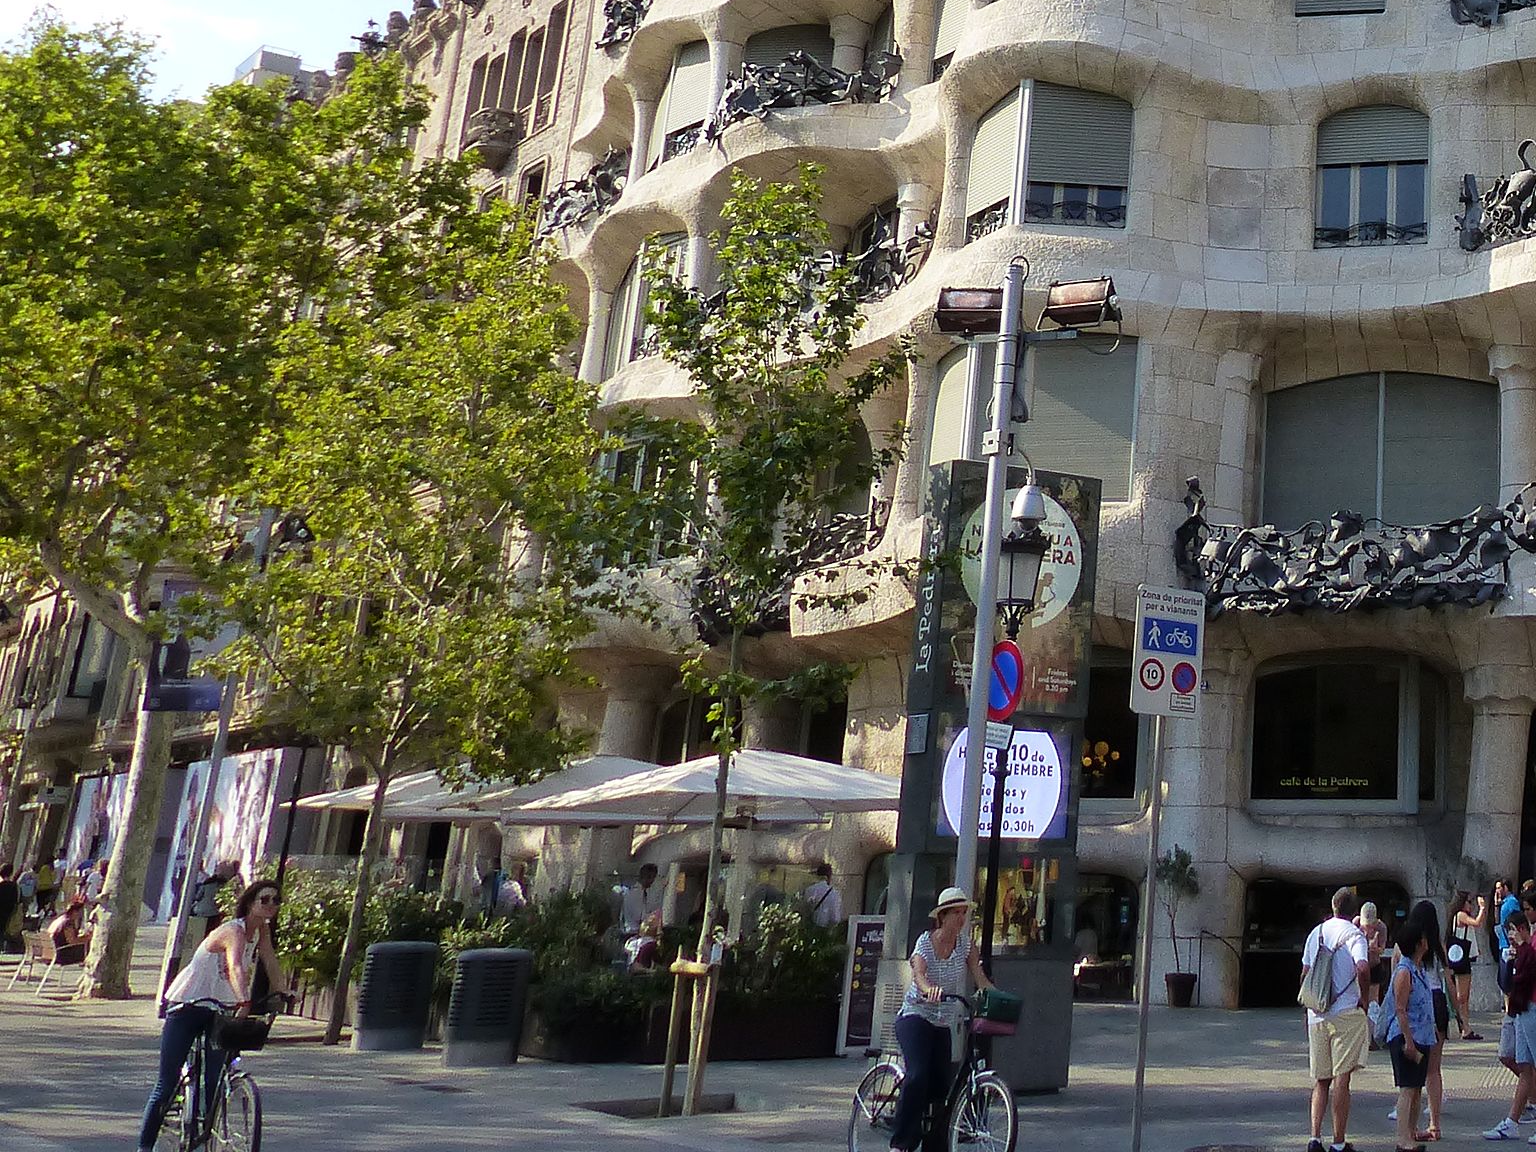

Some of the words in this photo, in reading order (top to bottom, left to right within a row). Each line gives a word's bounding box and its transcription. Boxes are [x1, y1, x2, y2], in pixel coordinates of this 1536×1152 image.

[1142, 590, 1160, 600] Zona
[1162, 593, 1172, 602] de
[1174, 595, 1202, 606] prioritat
[1145, 602, 1158, 612] per
[1166, 605, 1198, 616] vianants
[1146, 668, 1158, 679] 10
[1011, 744, 1029, 761] 10
[1031, 750, 1045, 762] de
[1303, 777, 1316, 786] de
[1318, 777, 1328, 786] la
[1330, 777, 1369, 786] Pedrera
[1020, 787, 1027, 800] y
